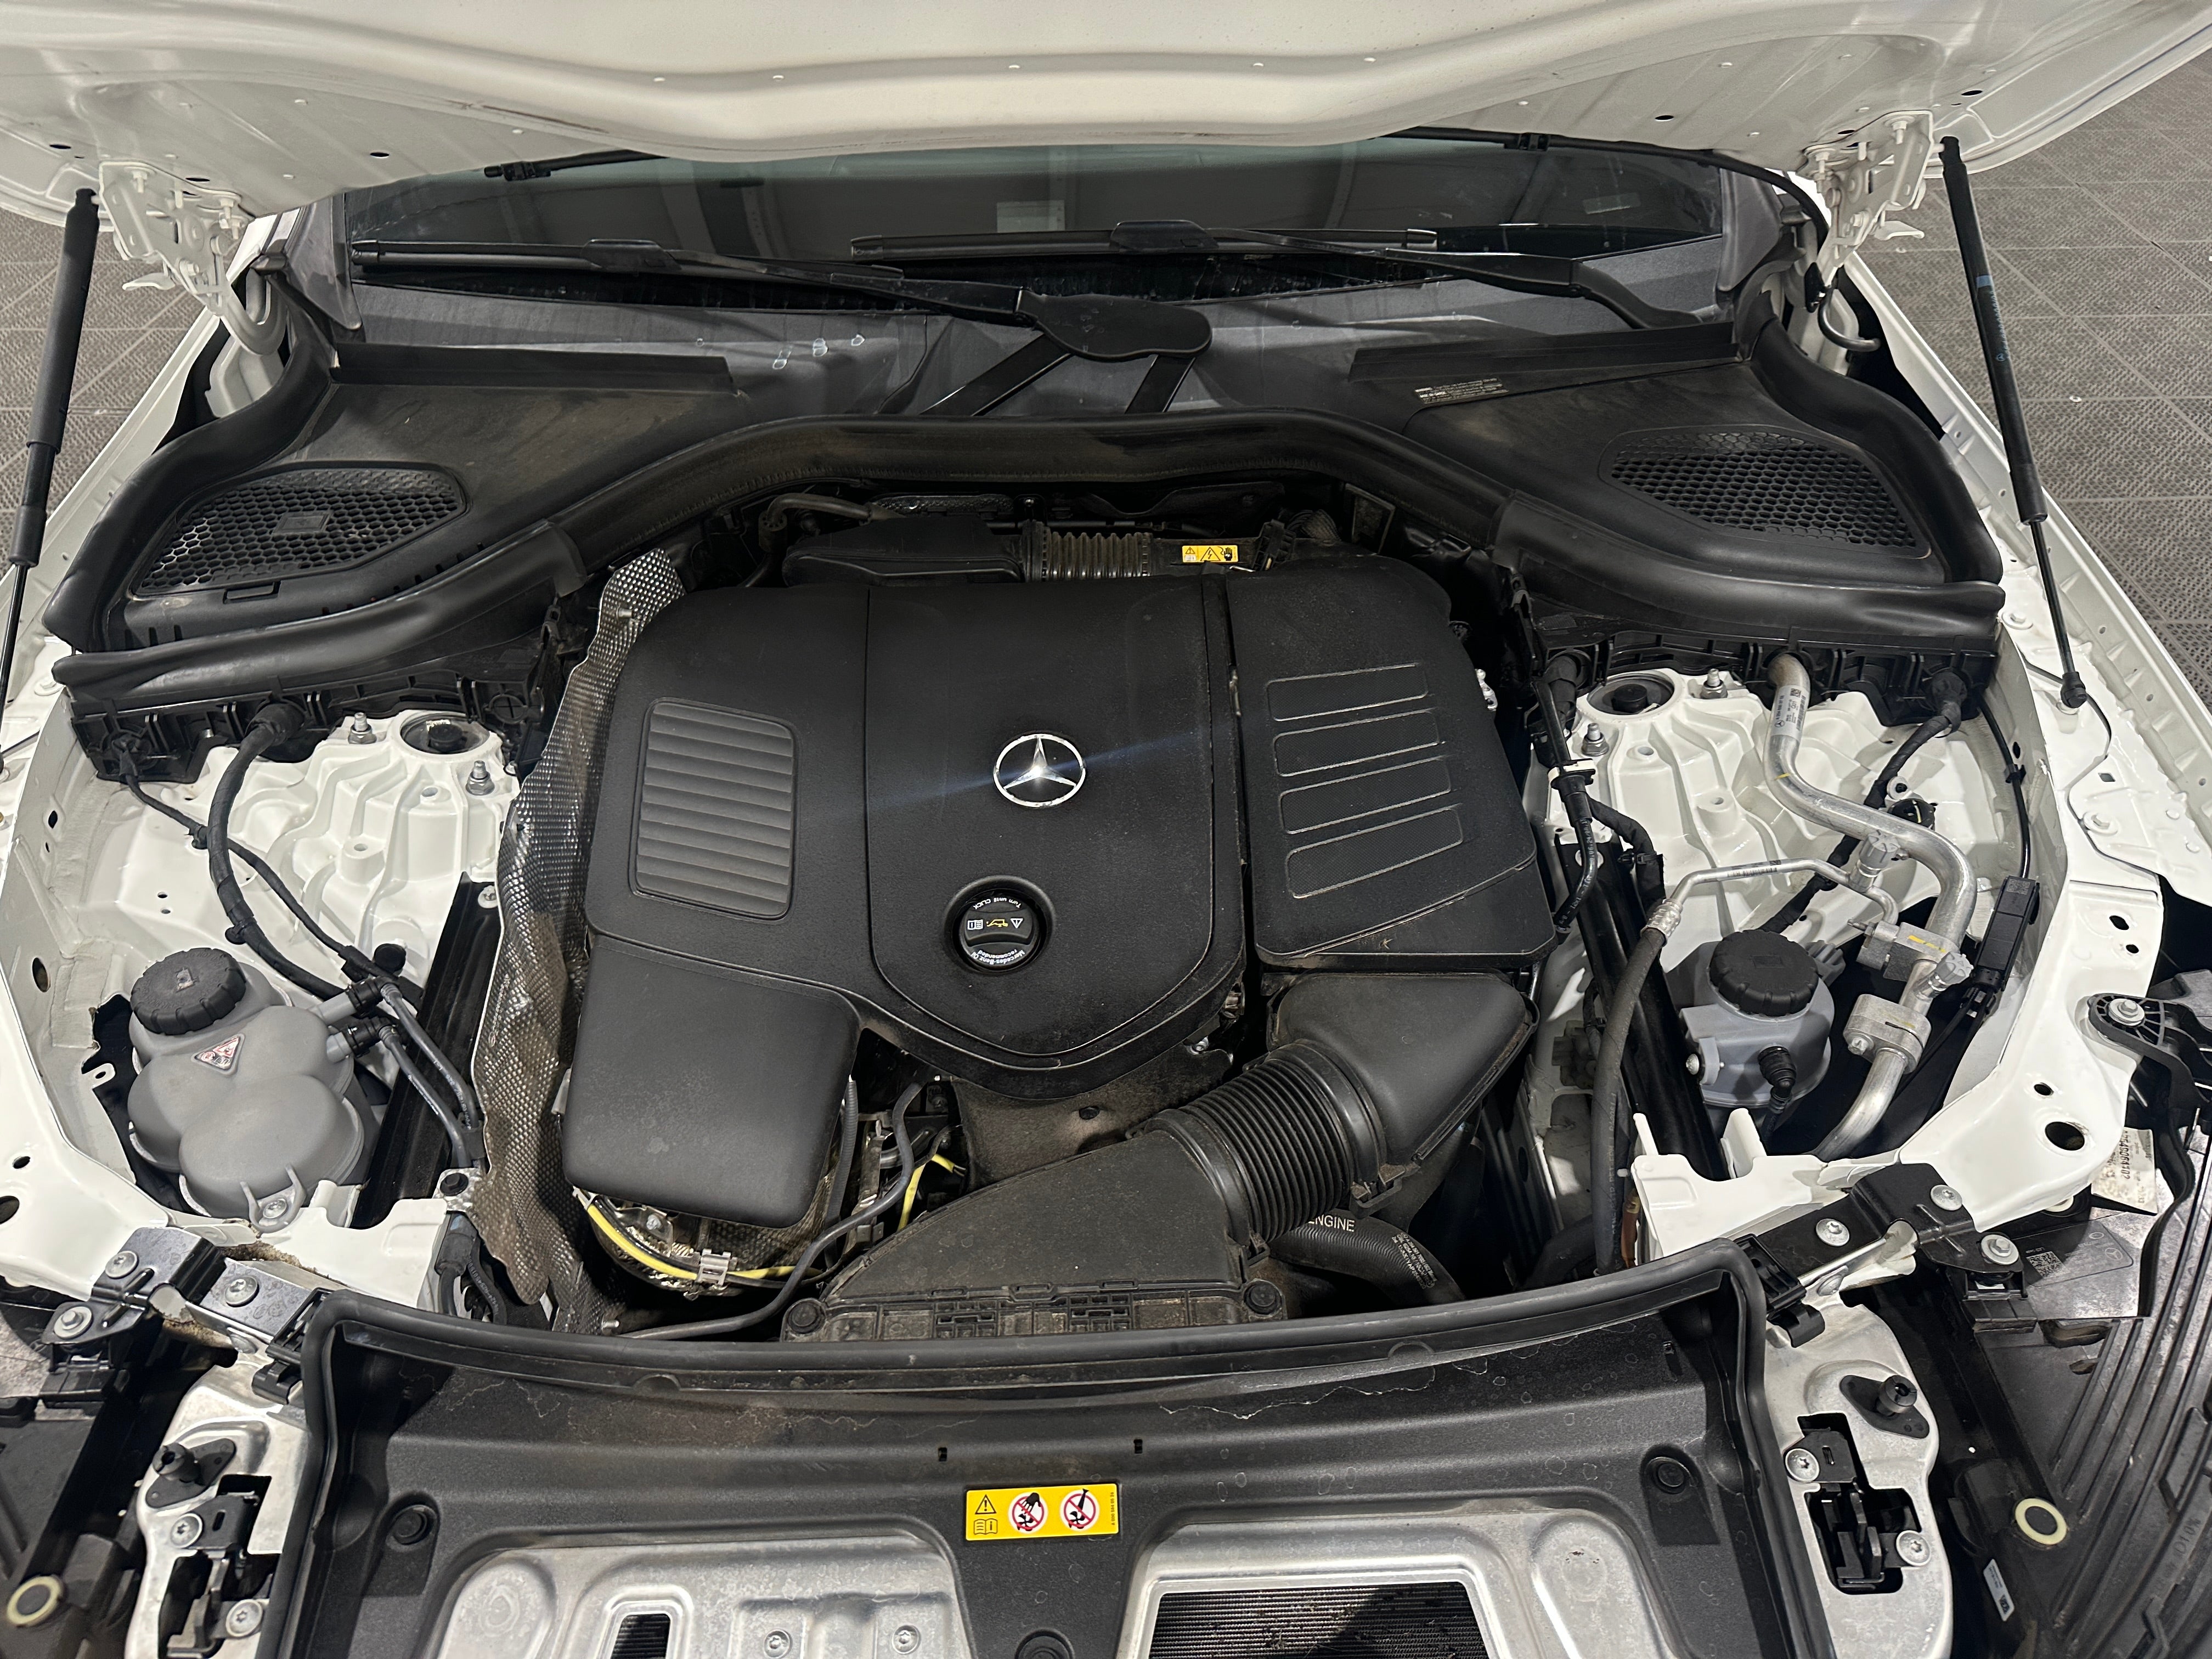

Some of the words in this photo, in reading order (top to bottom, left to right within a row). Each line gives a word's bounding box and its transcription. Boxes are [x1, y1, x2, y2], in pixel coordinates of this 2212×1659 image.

[973, 899, 991, 910] CLICK
[1008, 899, 1022, 909] Turn
[970, 951, 980, 960] Oil
[977, 949, 1018, 959] recommended
[980, 950, 1026, 965] Mercedes-Benz
[1308, 1214, 1356, 1232] NGINE
